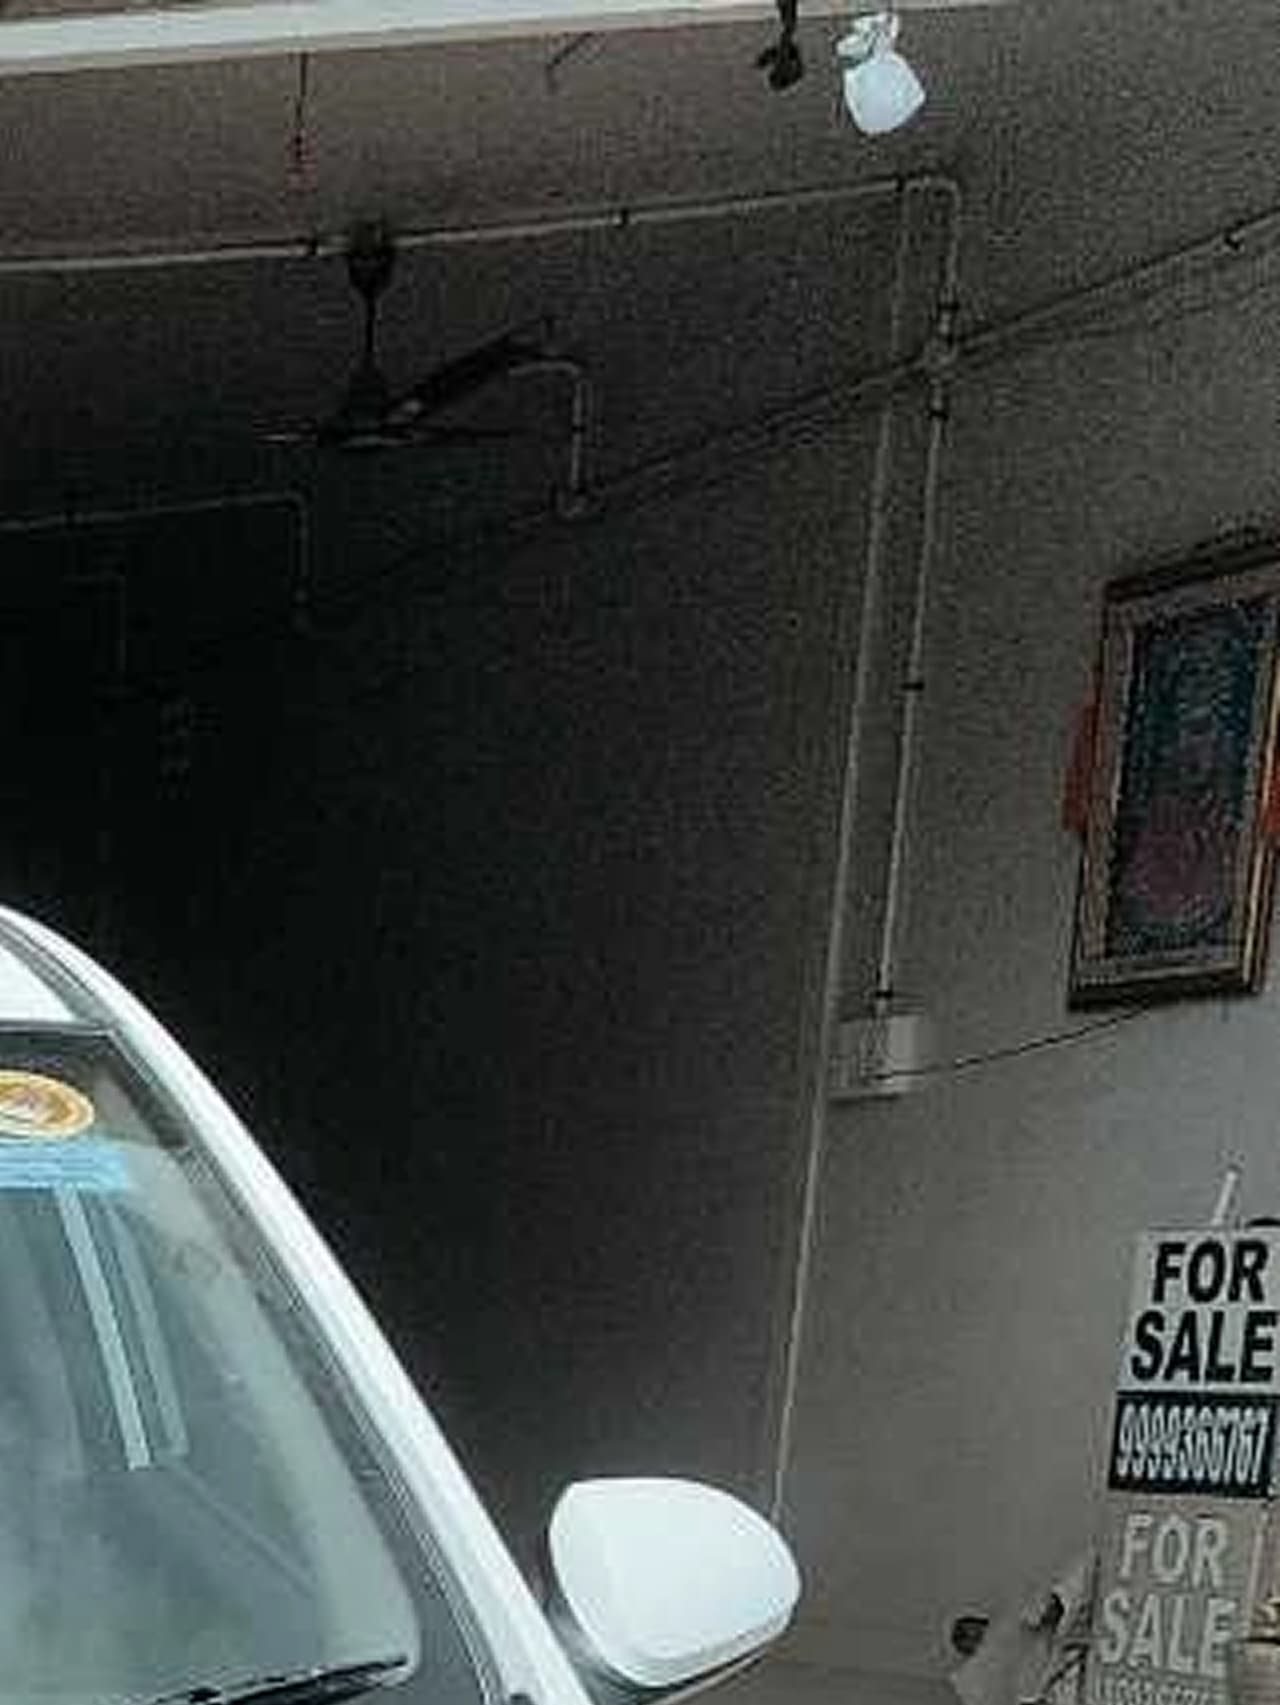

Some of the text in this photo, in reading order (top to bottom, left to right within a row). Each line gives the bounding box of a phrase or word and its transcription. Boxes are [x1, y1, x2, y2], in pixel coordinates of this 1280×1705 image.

[1152, 1240, 1268, 1304] FOR
[1130, 1309, 1278, 1382] SALE
[1121, 1514, 1228, 1588] FOR
[1101, 1590, 1237, 1680] SALE
